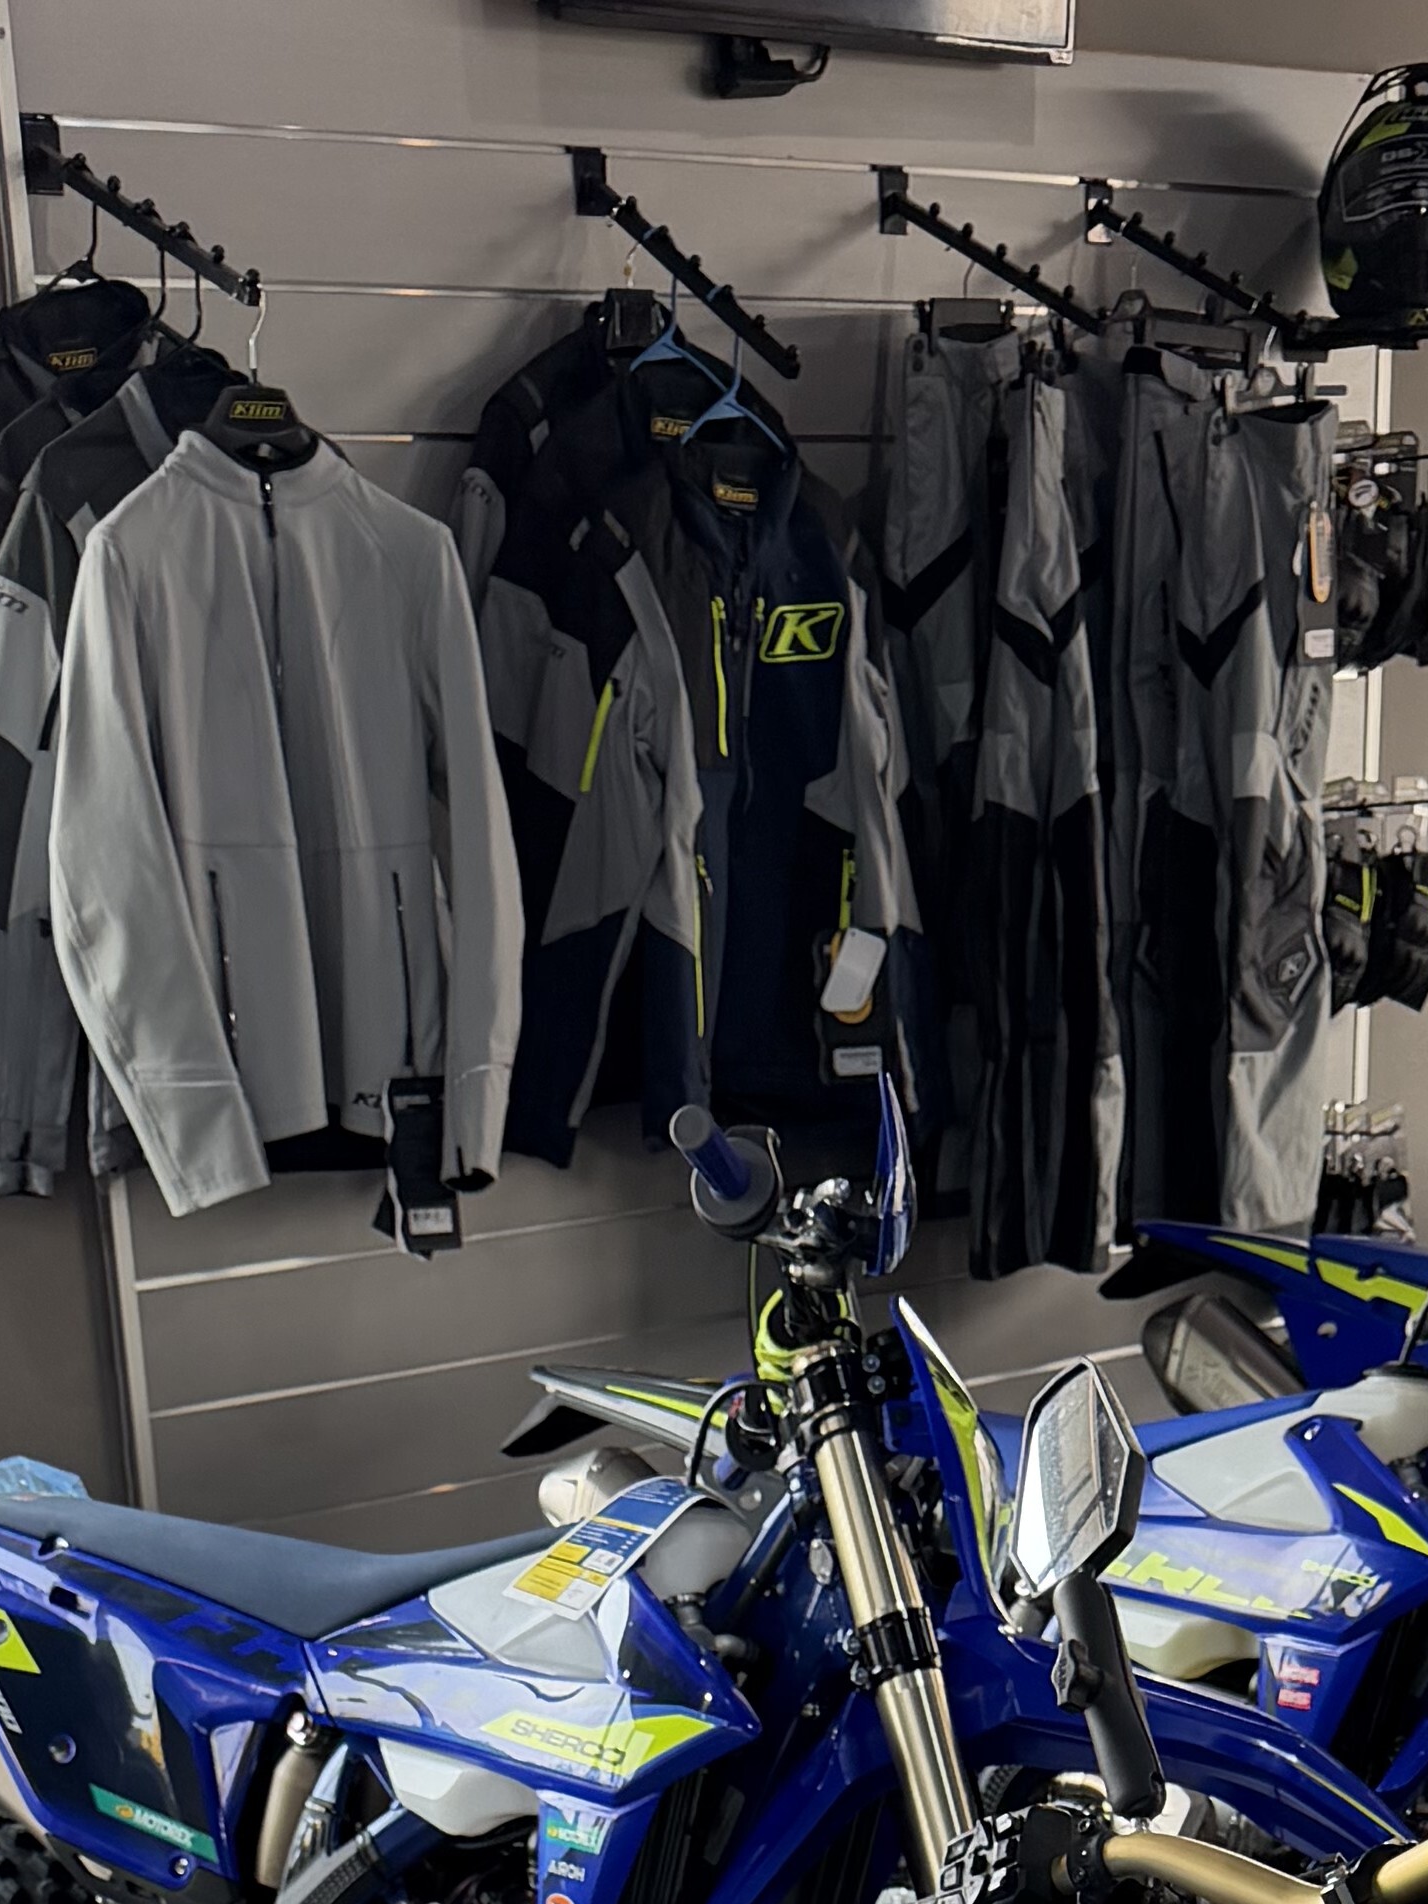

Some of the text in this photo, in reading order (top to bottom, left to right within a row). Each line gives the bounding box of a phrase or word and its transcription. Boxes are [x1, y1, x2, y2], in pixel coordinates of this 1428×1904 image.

[231, 402, 283, 418] Klim
[767, 609, 837, 657] K
[510, 1717, 627, 1767] SHERCO
[133, 1807, 195, 1850] MOTOREX
